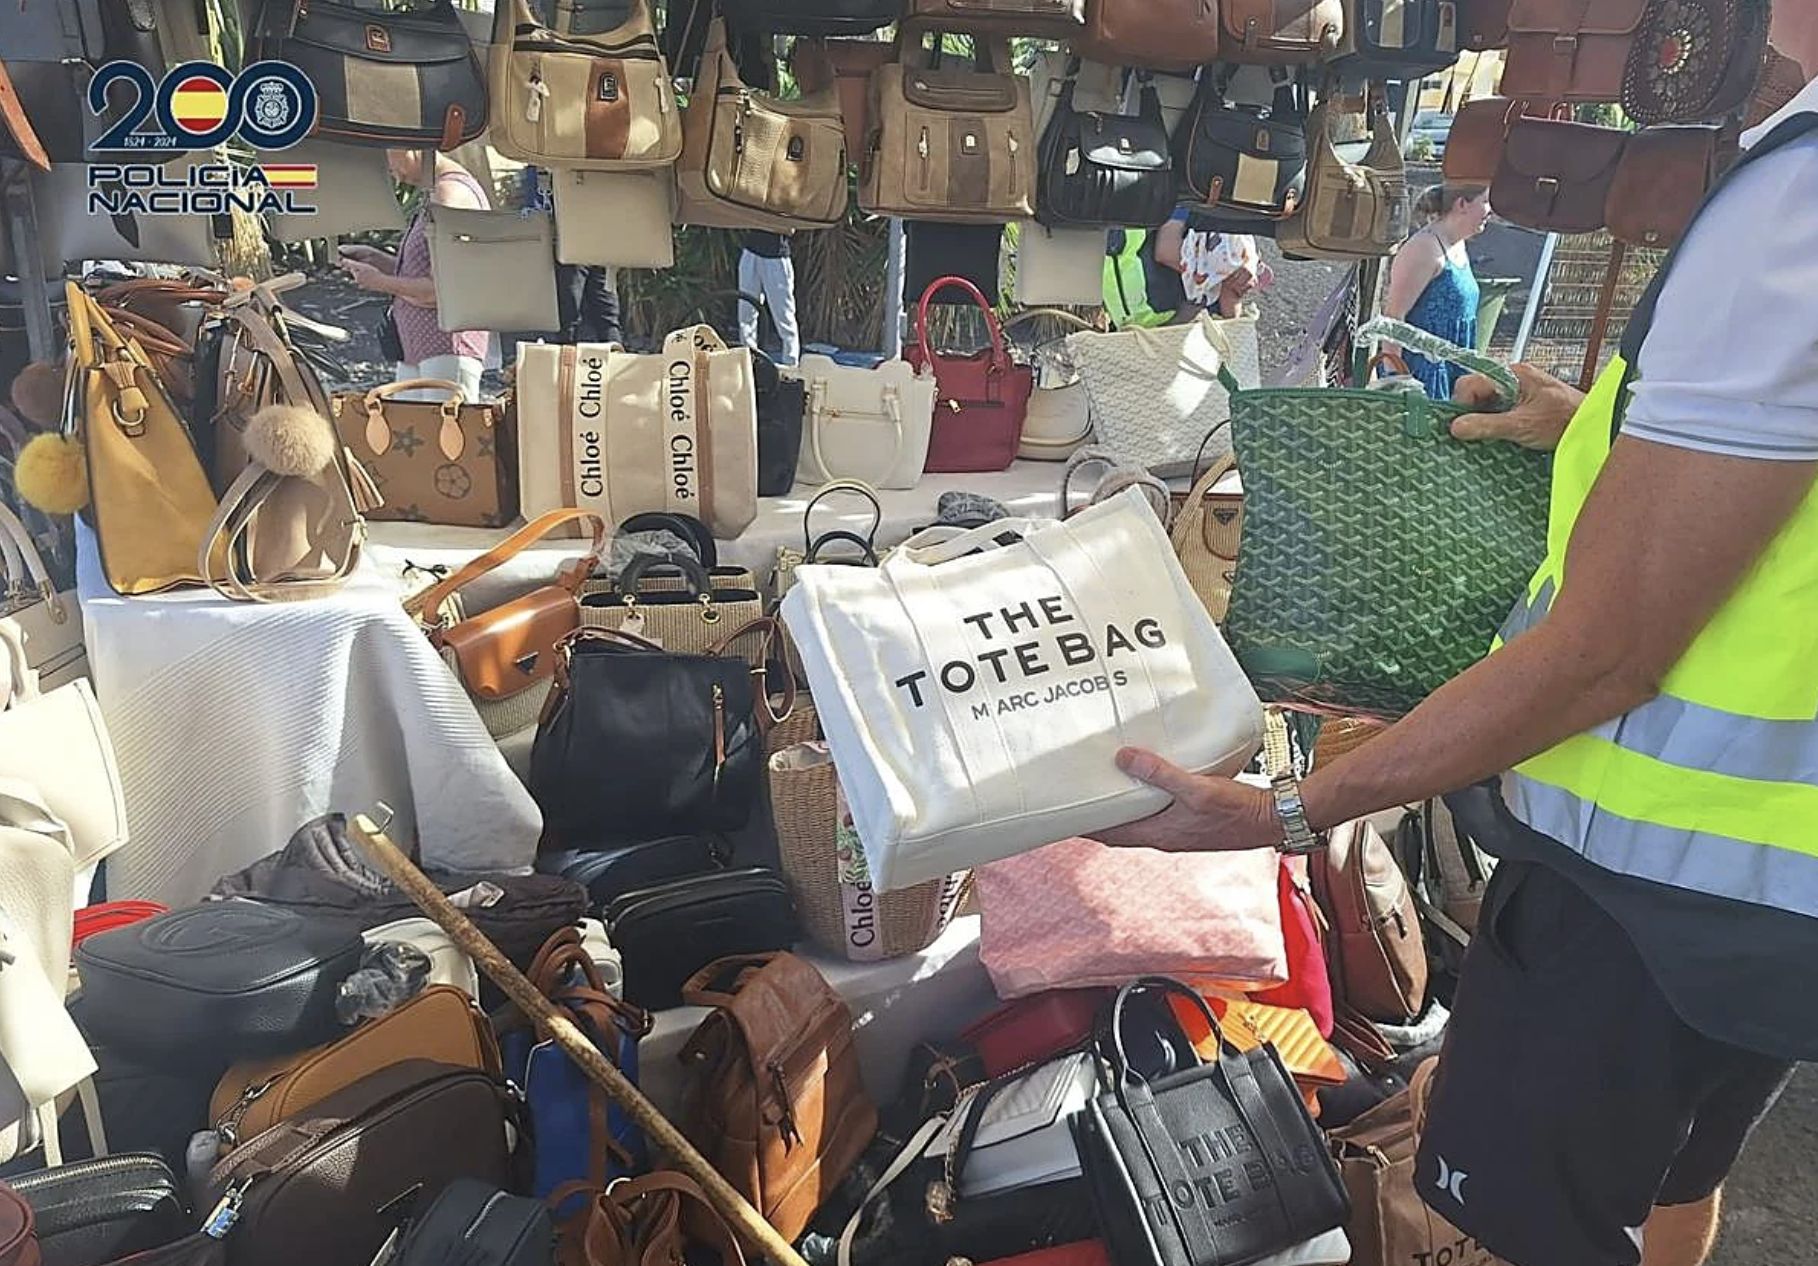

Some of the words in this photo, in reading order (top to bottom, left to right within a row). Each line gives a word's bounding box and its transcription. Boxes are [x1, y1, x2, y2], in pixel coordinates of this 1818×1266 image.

[579, 357, 603, 418] Chloé
[669, 360, 691, 422] Chloé
[579, 431, 604, 497] Chloé
[670, 434, 695, 500] Chloé
[963, 595, 1074, 640] THE
[895, 641, 1050, 708] TOTE
[1056, 618, 1167, 667] BAG
[971, 691, 1040, 721] MARC
[1043, 669, 1129, 704] JACOBS
[1179, 1122, 1252, 1168] THE
[1411, 1236, 1480, 1266] TOT
